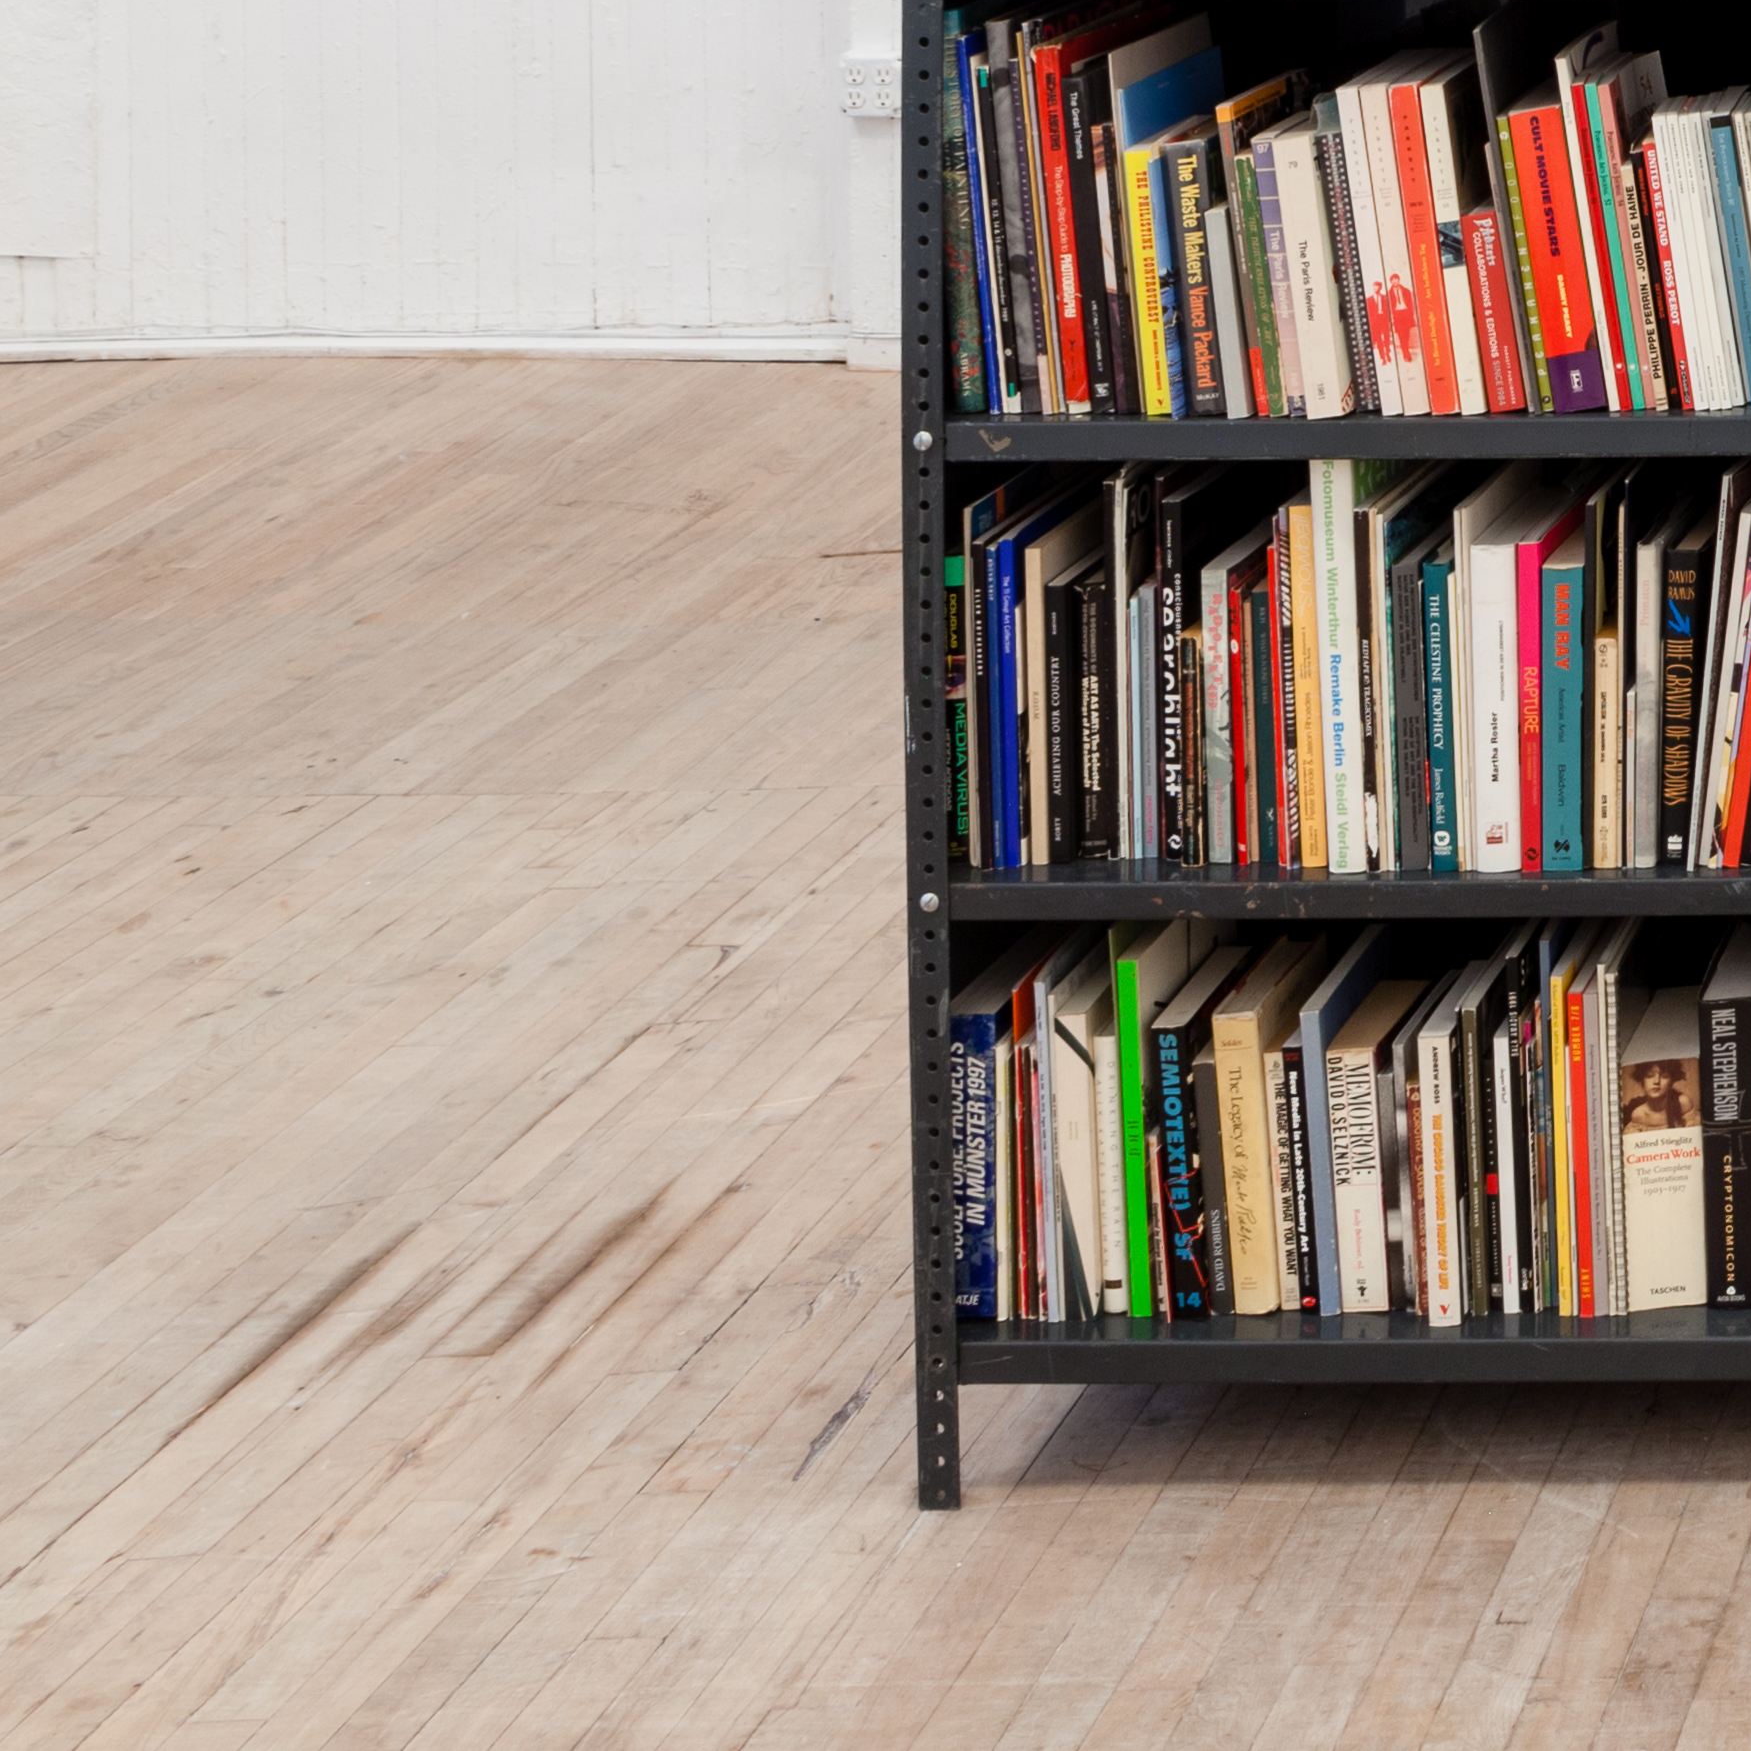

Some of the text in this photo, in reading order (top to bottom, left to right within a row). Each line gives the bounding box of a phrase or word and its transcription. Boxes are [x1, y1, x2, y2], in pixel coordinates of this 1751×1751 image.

[1136, 171, 1159, 323] THE PHILISTINE CONTROVERSY
[1529, 116, 1560, 257] CULT MOVIE STARS
[1176, 155, 1216, 387] The Waste Makers Vance Packard
[1322, 460, 1351, 869] Fotomuseum Winterthur Remake Berlin Steidl Verlag
[1430, 595, 1444, 749] THE CELESTINE PROPHECY
[1524, 666, 1539, 734] RAPTURE
[1664, 639, 1694, 806] THE GRAVITY OF SHADOWS
[1159, 1033, 1193, 1261] SEMIOTEXT(E) SF
[1346, 1063, 1377, 1175] MEMO FROM:
[1711, 1008, 1738, 1281] NEAL STEPHENSON CRYPTONOMICON
